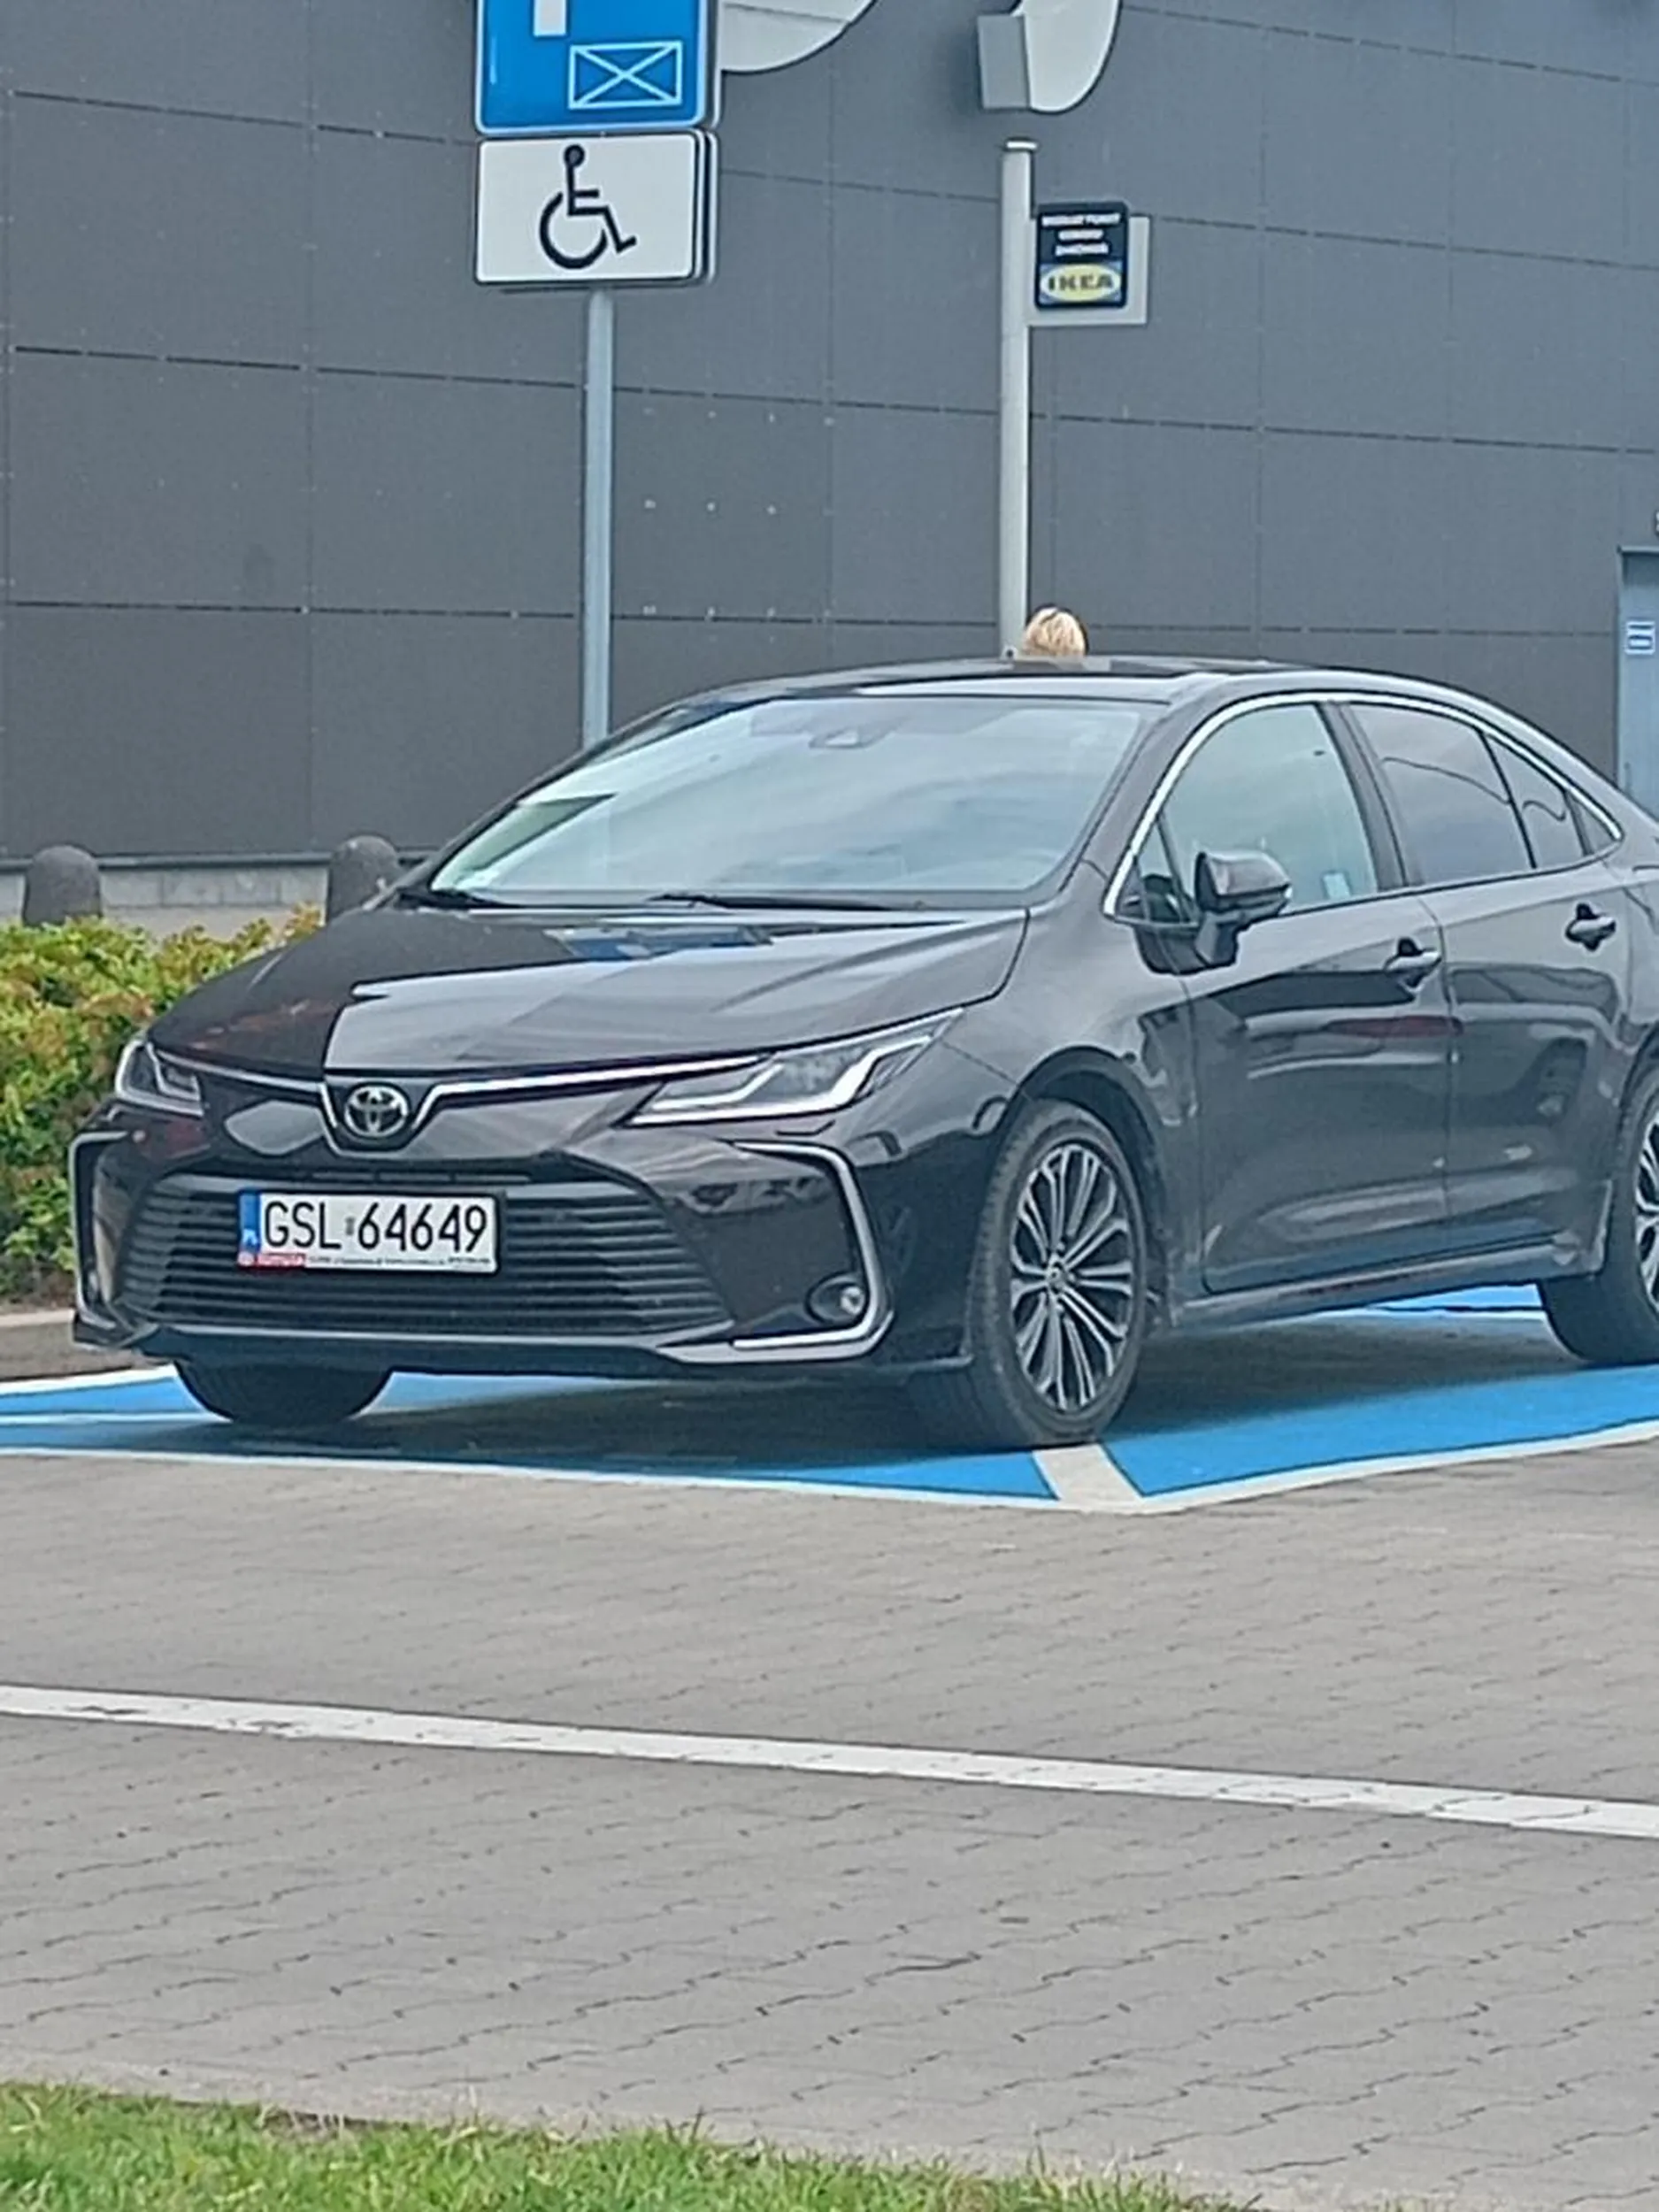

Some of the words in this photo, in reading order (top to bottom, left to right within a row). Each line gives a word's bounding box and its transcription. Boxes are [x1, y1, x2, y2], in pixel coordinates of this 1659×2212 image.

[1048, 274, 1114, 291] IKEA
[265, 1201, 342, 1249] GSL
[357, 1201, 488, 1253] 64649
